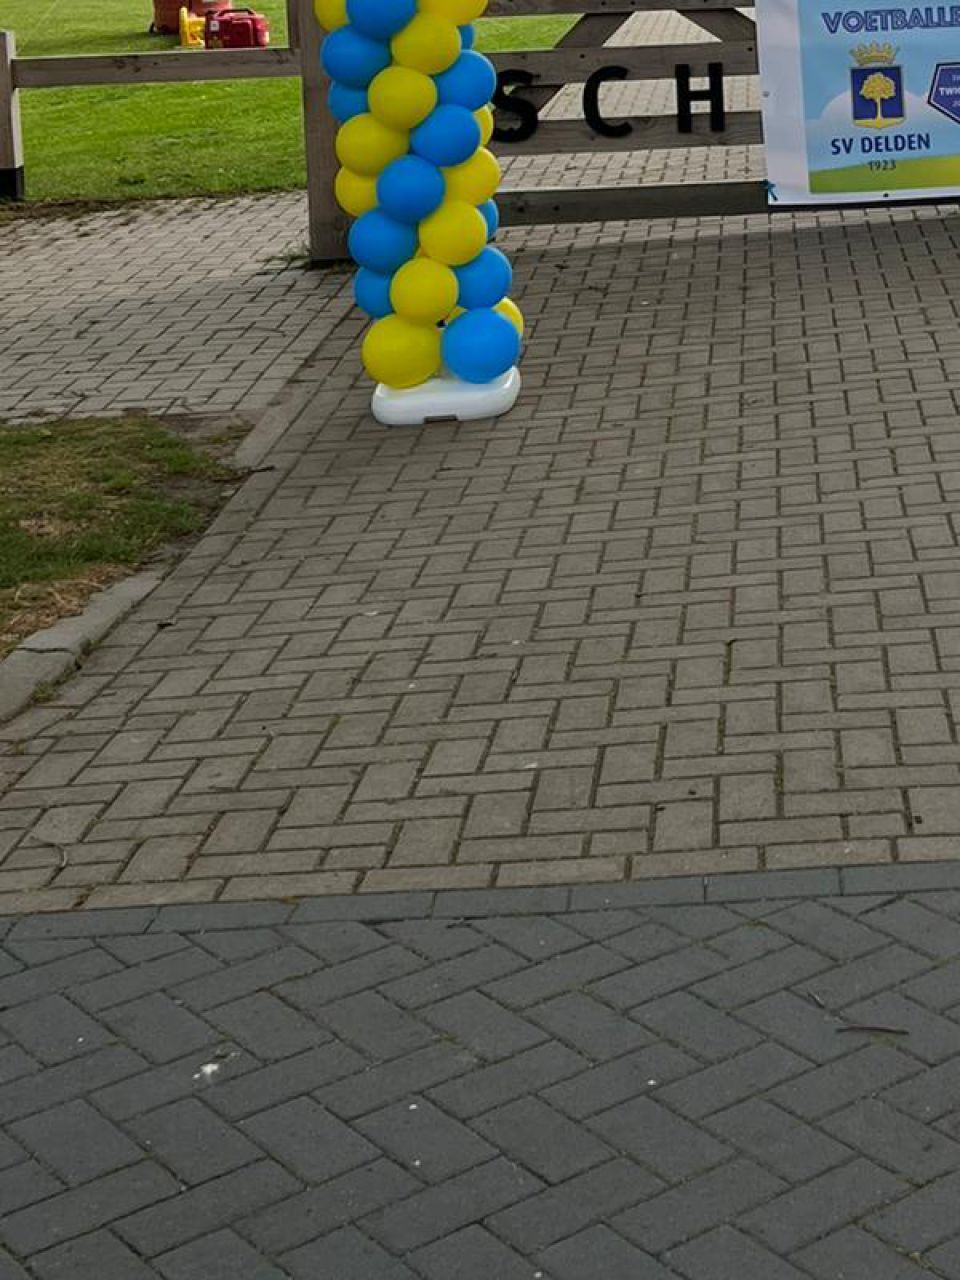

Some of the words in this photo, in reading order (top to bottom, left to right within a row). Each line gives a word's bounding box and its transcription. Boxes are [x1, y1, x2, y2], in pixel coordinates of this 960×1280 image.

[831, 138, 853, 156] SV
[861, 132, 931, 154] DELDEN
[868, 159, 897, 171] 1923
